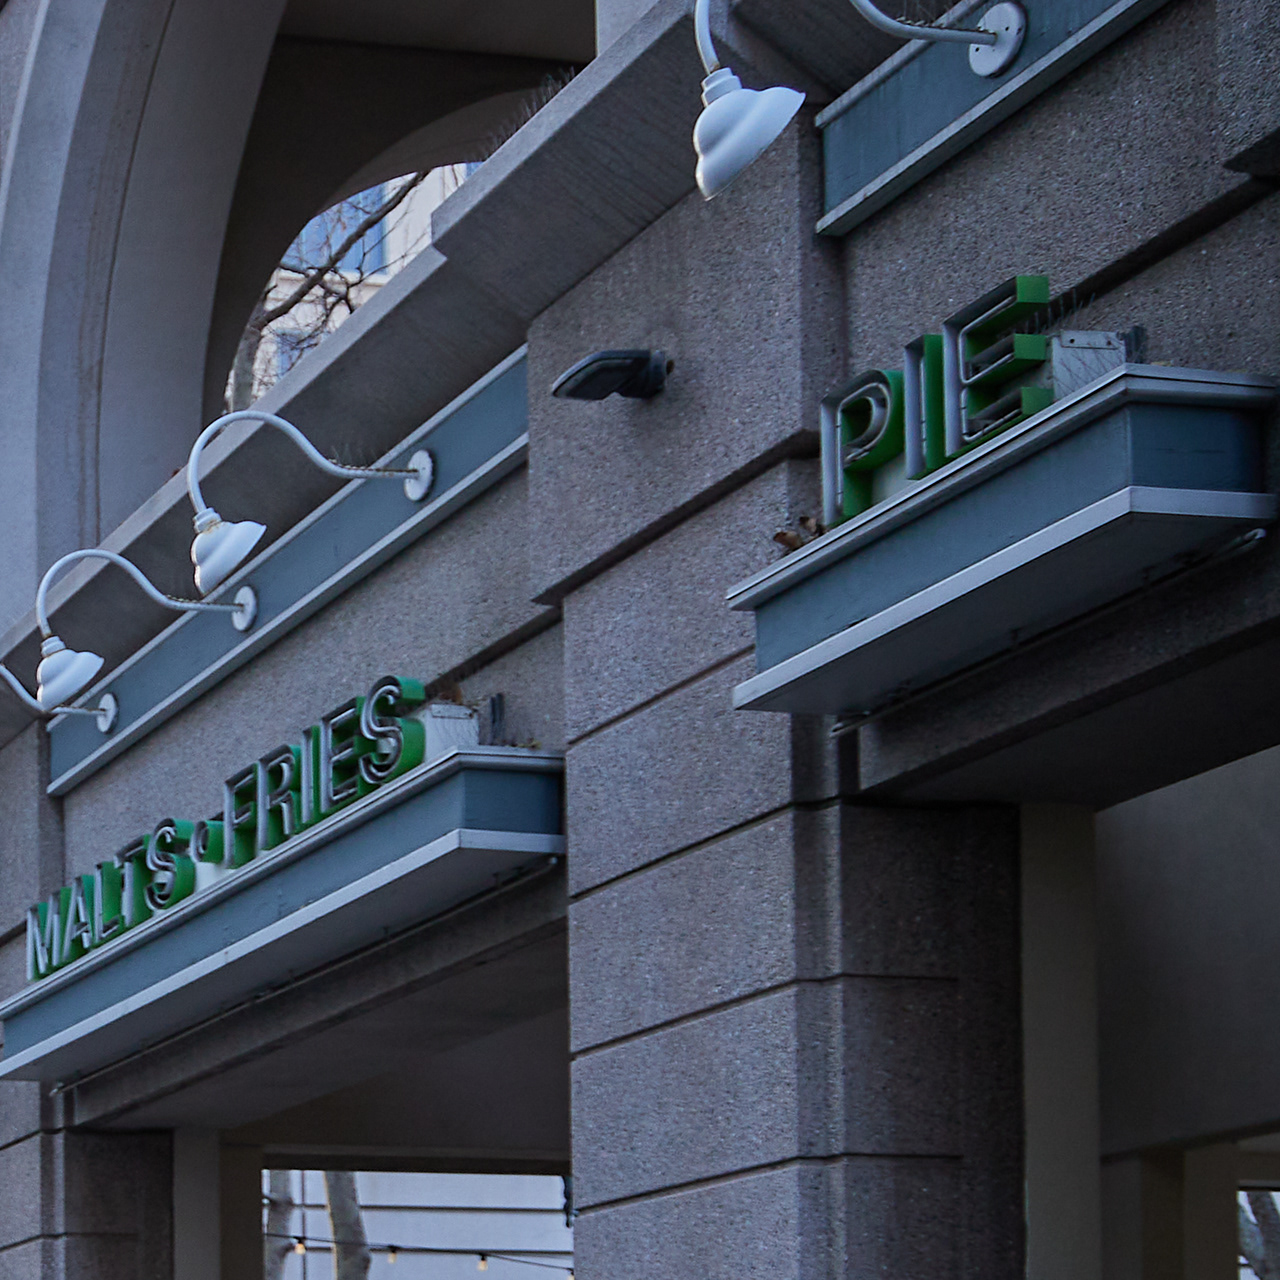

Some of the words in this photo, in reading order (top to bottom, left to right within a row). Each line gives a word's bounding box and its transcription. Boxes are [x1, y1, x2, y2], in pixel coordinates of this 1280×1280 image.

[820, 275, 1055, 527] PIE
[26, 817, 196, 981] MALTS
[223, 675, 426, 869] FRIES
